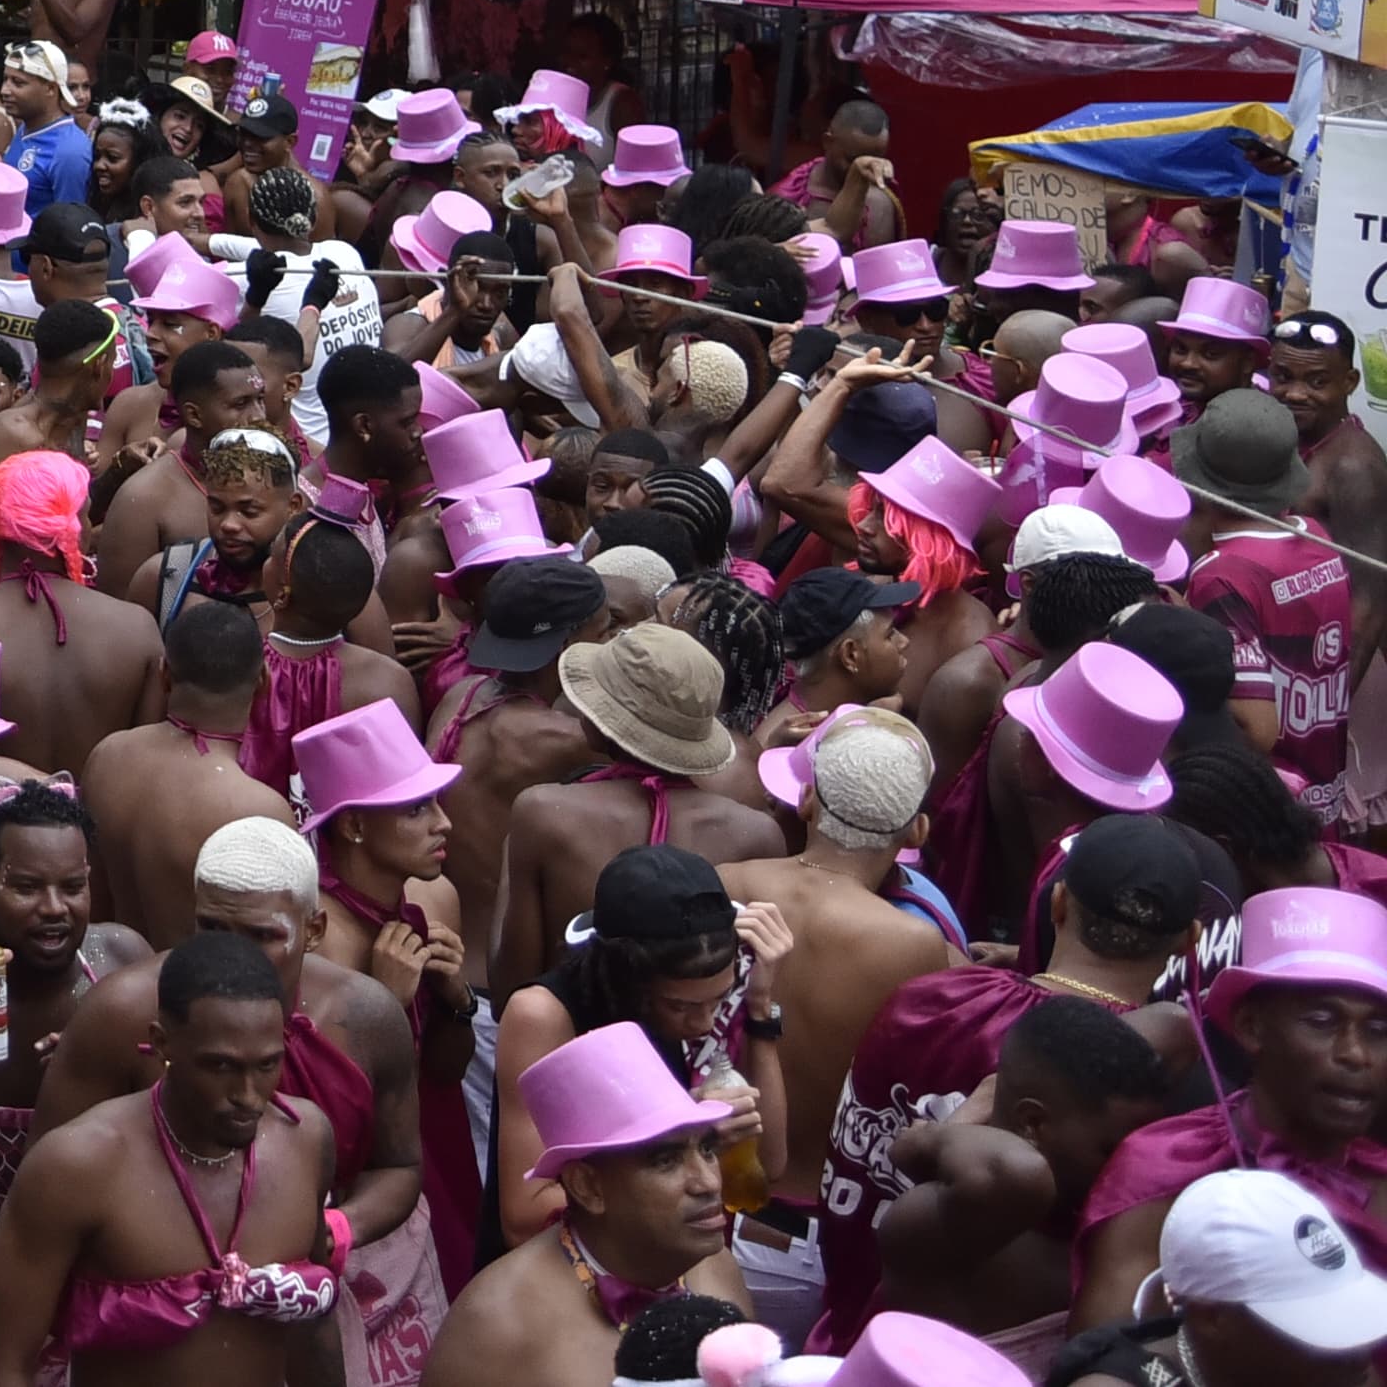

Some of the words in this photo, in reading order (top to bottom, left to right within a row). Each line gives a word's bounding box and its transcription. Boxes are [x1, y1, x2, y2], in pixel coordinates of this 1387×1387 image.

[1007, 168, 1077, 199] TEMOS
[1008, 199, 1078, 227] CALDO
[1081, 206, 1106, 230] DE
[319, 300, 379, 338] DEPÓSITO
